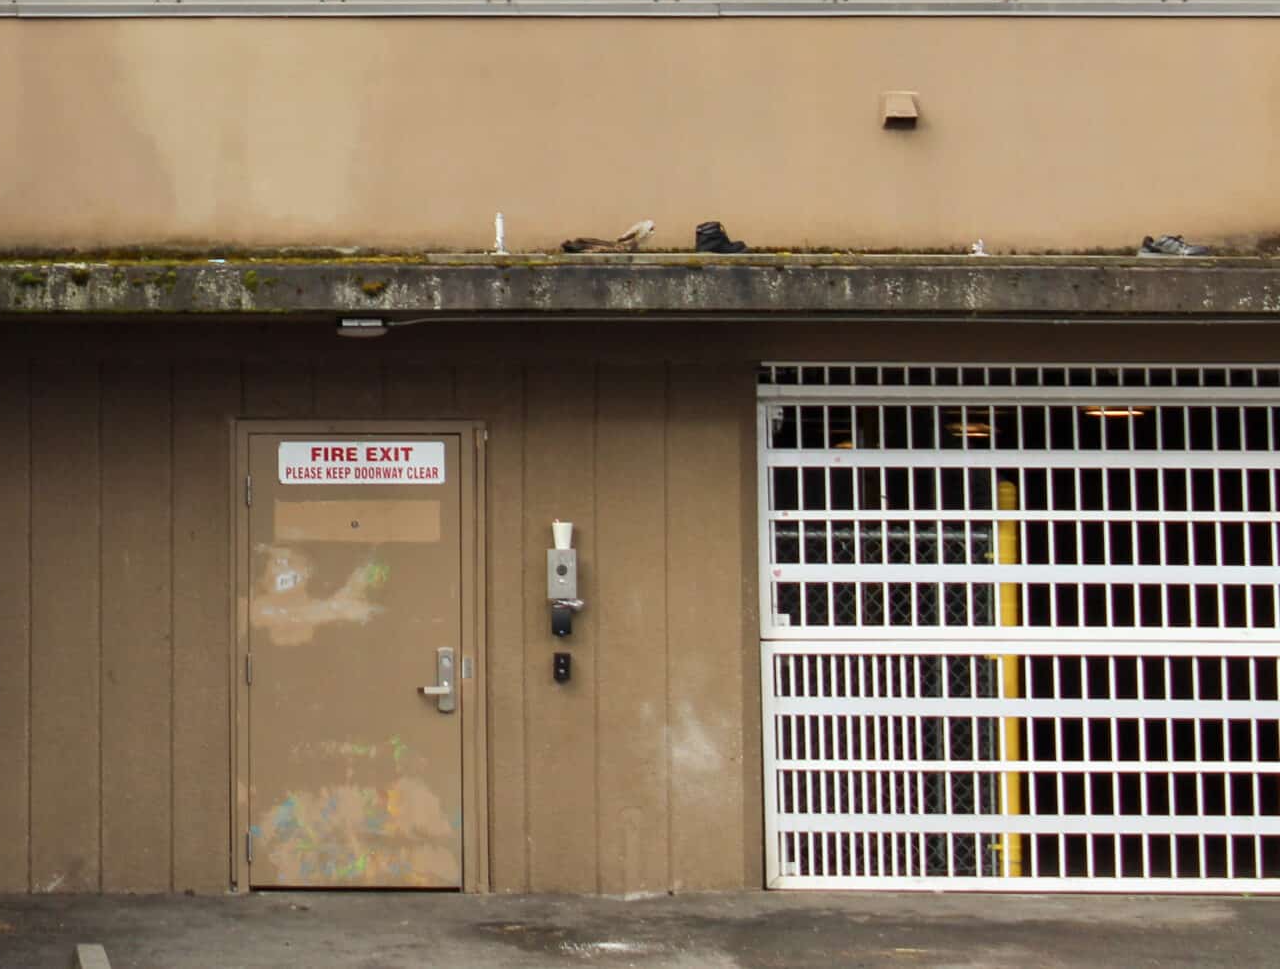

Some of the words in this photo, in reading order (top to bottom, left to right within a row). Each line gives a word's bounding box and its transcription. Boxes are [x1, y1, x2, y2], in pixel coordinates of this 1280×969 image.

[311, 447, 358, 462] FIRE
[366, 447, 413, 462] EXIT
[286, 466, 322, 479] PLEASE
[326, 466, 351, 479] KEEP
[354, 466, 403, 479] DOORWAY
[407, 466, 438, 479] CLEAR
